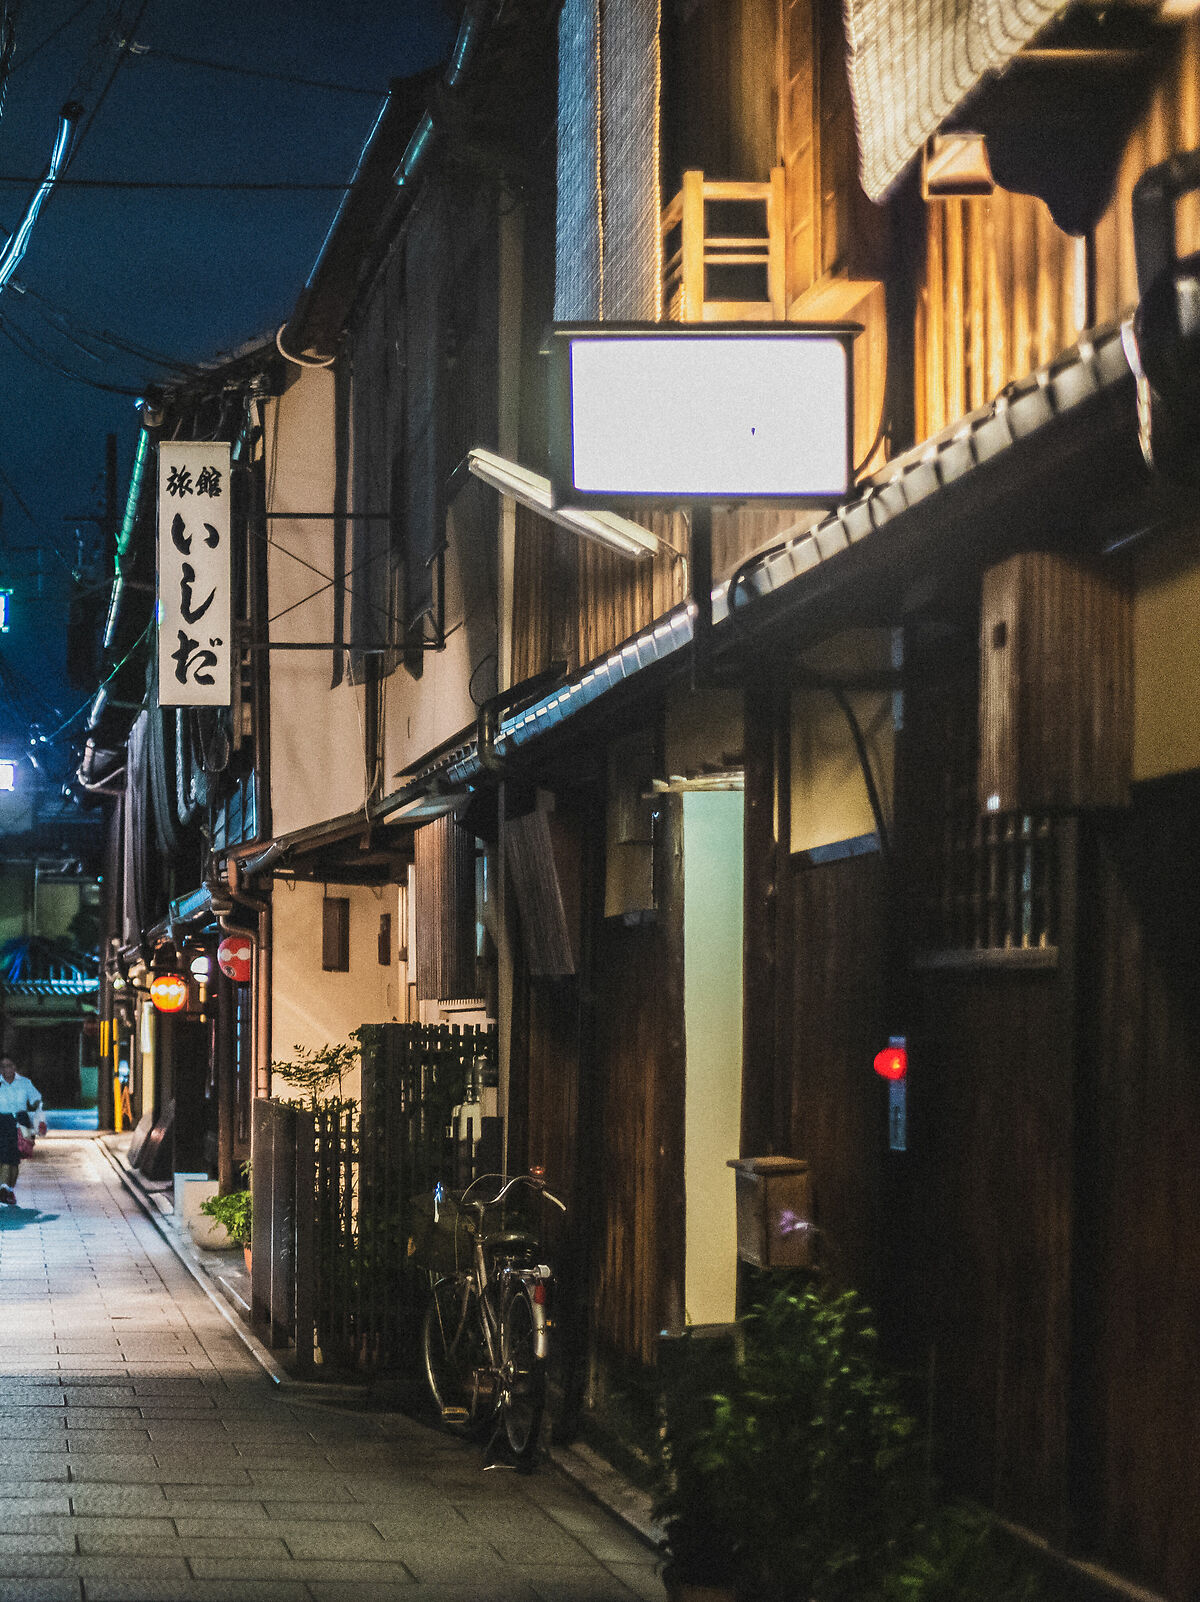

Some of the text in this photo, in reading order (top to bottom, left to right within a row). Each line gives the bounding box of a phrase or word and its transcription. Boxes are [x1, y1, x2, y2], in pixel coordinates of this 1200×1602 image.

[166, 465, 222, 498] 旅館
[171, 513, 222, 685] いしだ
